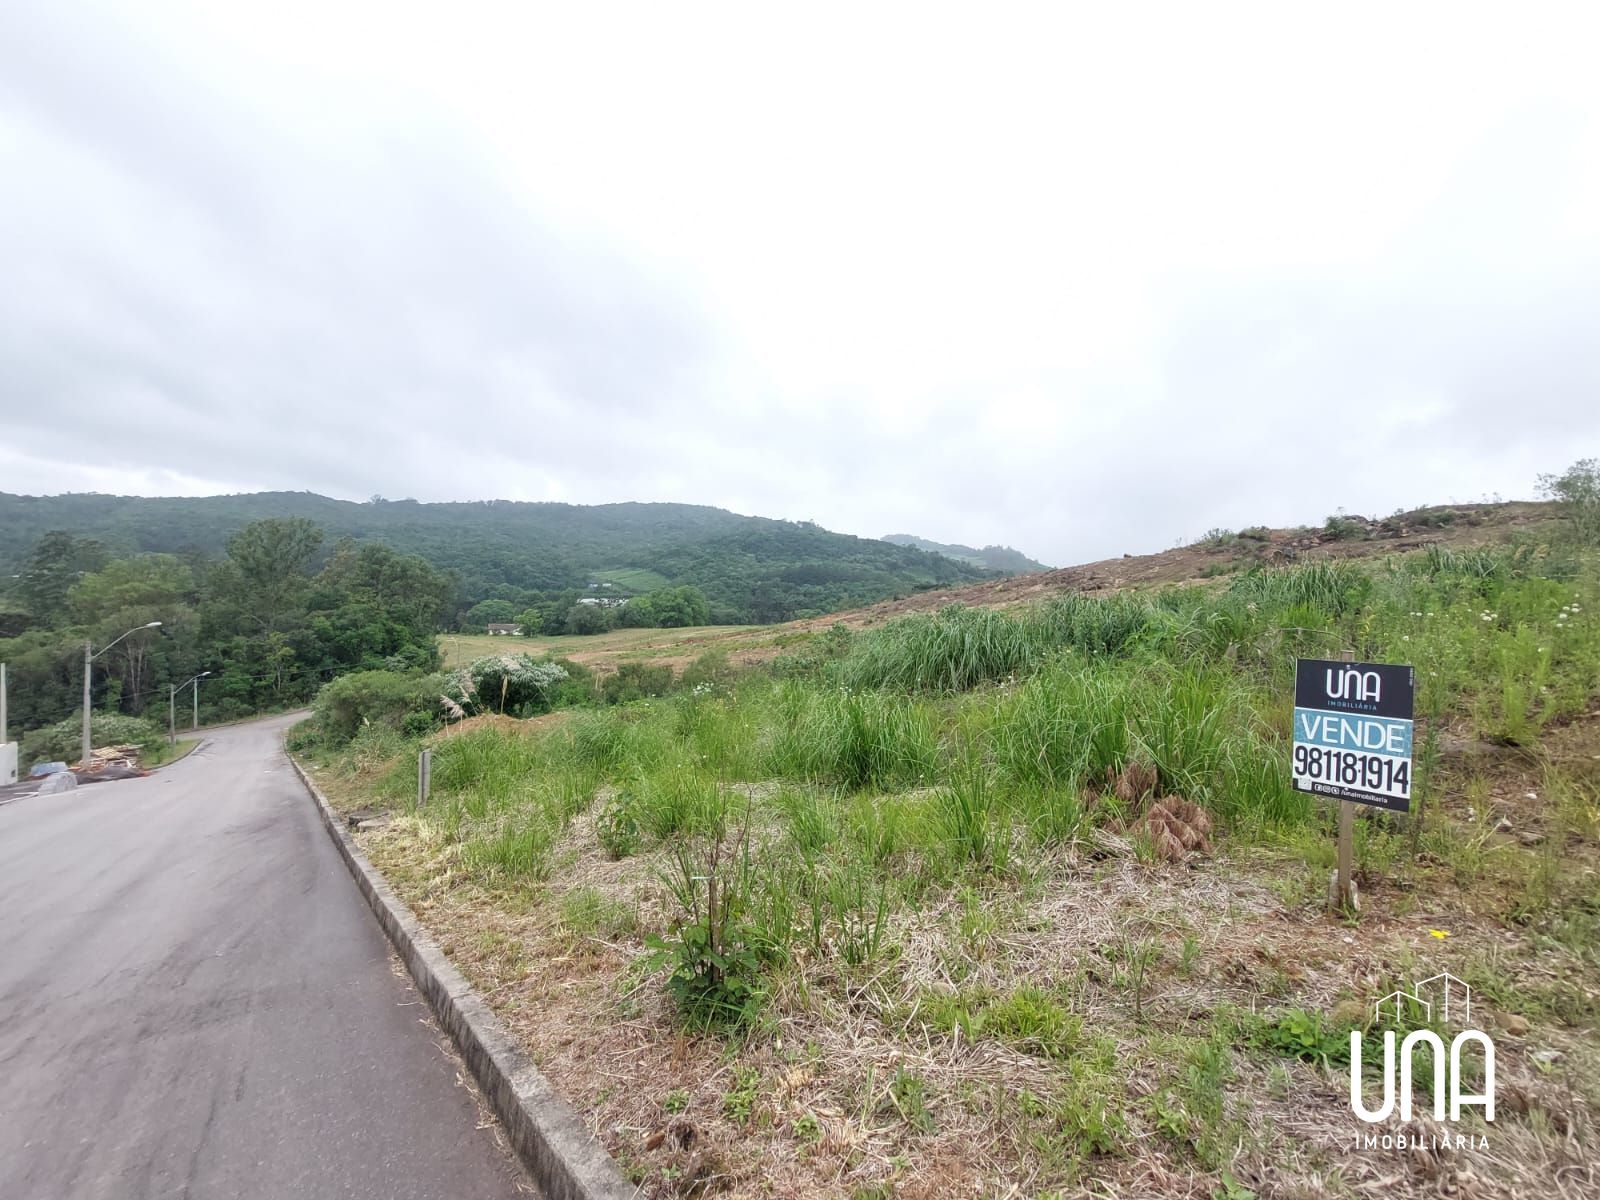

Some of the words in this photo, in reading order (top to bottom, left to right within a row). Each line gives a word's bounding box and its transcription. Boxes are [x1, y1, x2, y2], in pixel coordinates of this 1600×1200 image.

[1326, 669, 1381, 702] UNA
[1328, 700, 1377, 711] IMOBILIÁRIA
[1301, 713, 1405, 753] VENDE
